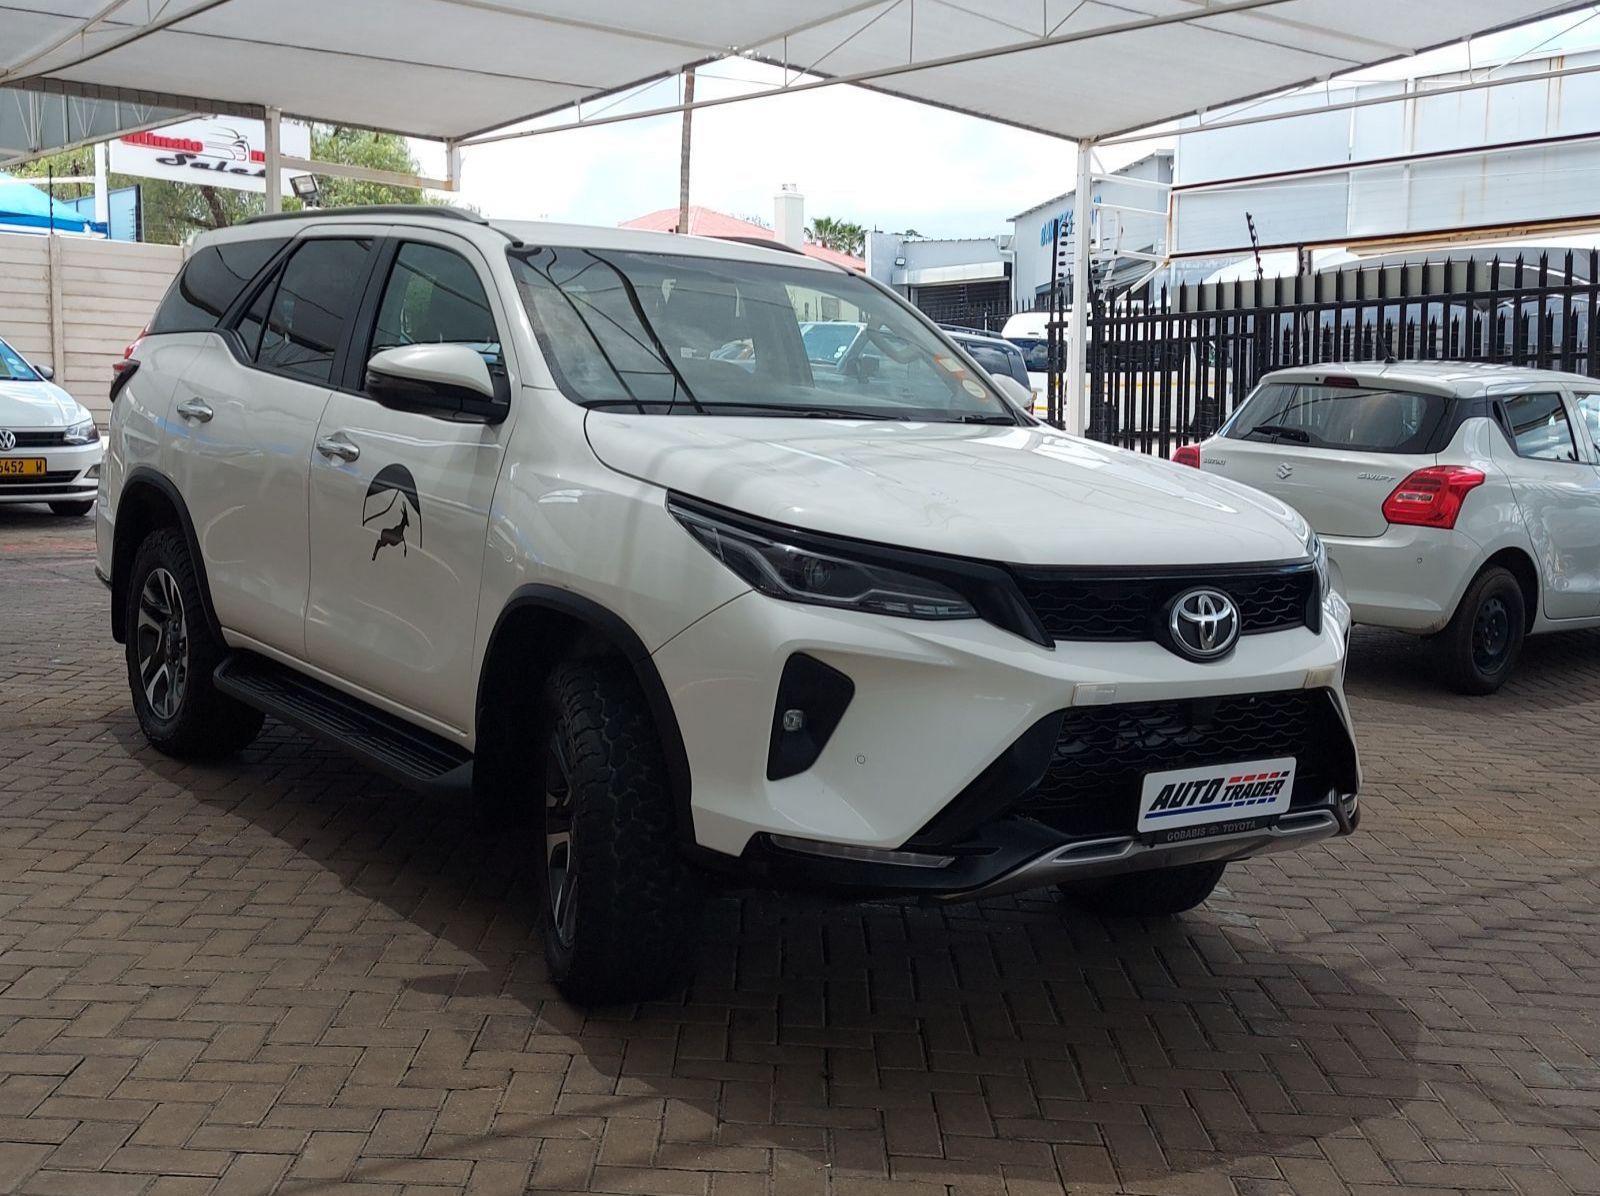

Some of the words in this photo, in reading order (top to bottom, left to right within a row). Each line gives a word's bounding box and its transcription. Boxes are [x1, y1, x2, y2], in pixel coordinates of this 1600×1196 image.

[1358, 471, 1396, 482] SWIFT
[1149, 778, 1225, 811] AUTO
[1221, 780, 1286, 802] TRADER
[1167, 827, 1206, 841] GOBABIS
[1223, 821, 1256, 833] TOYOTA
